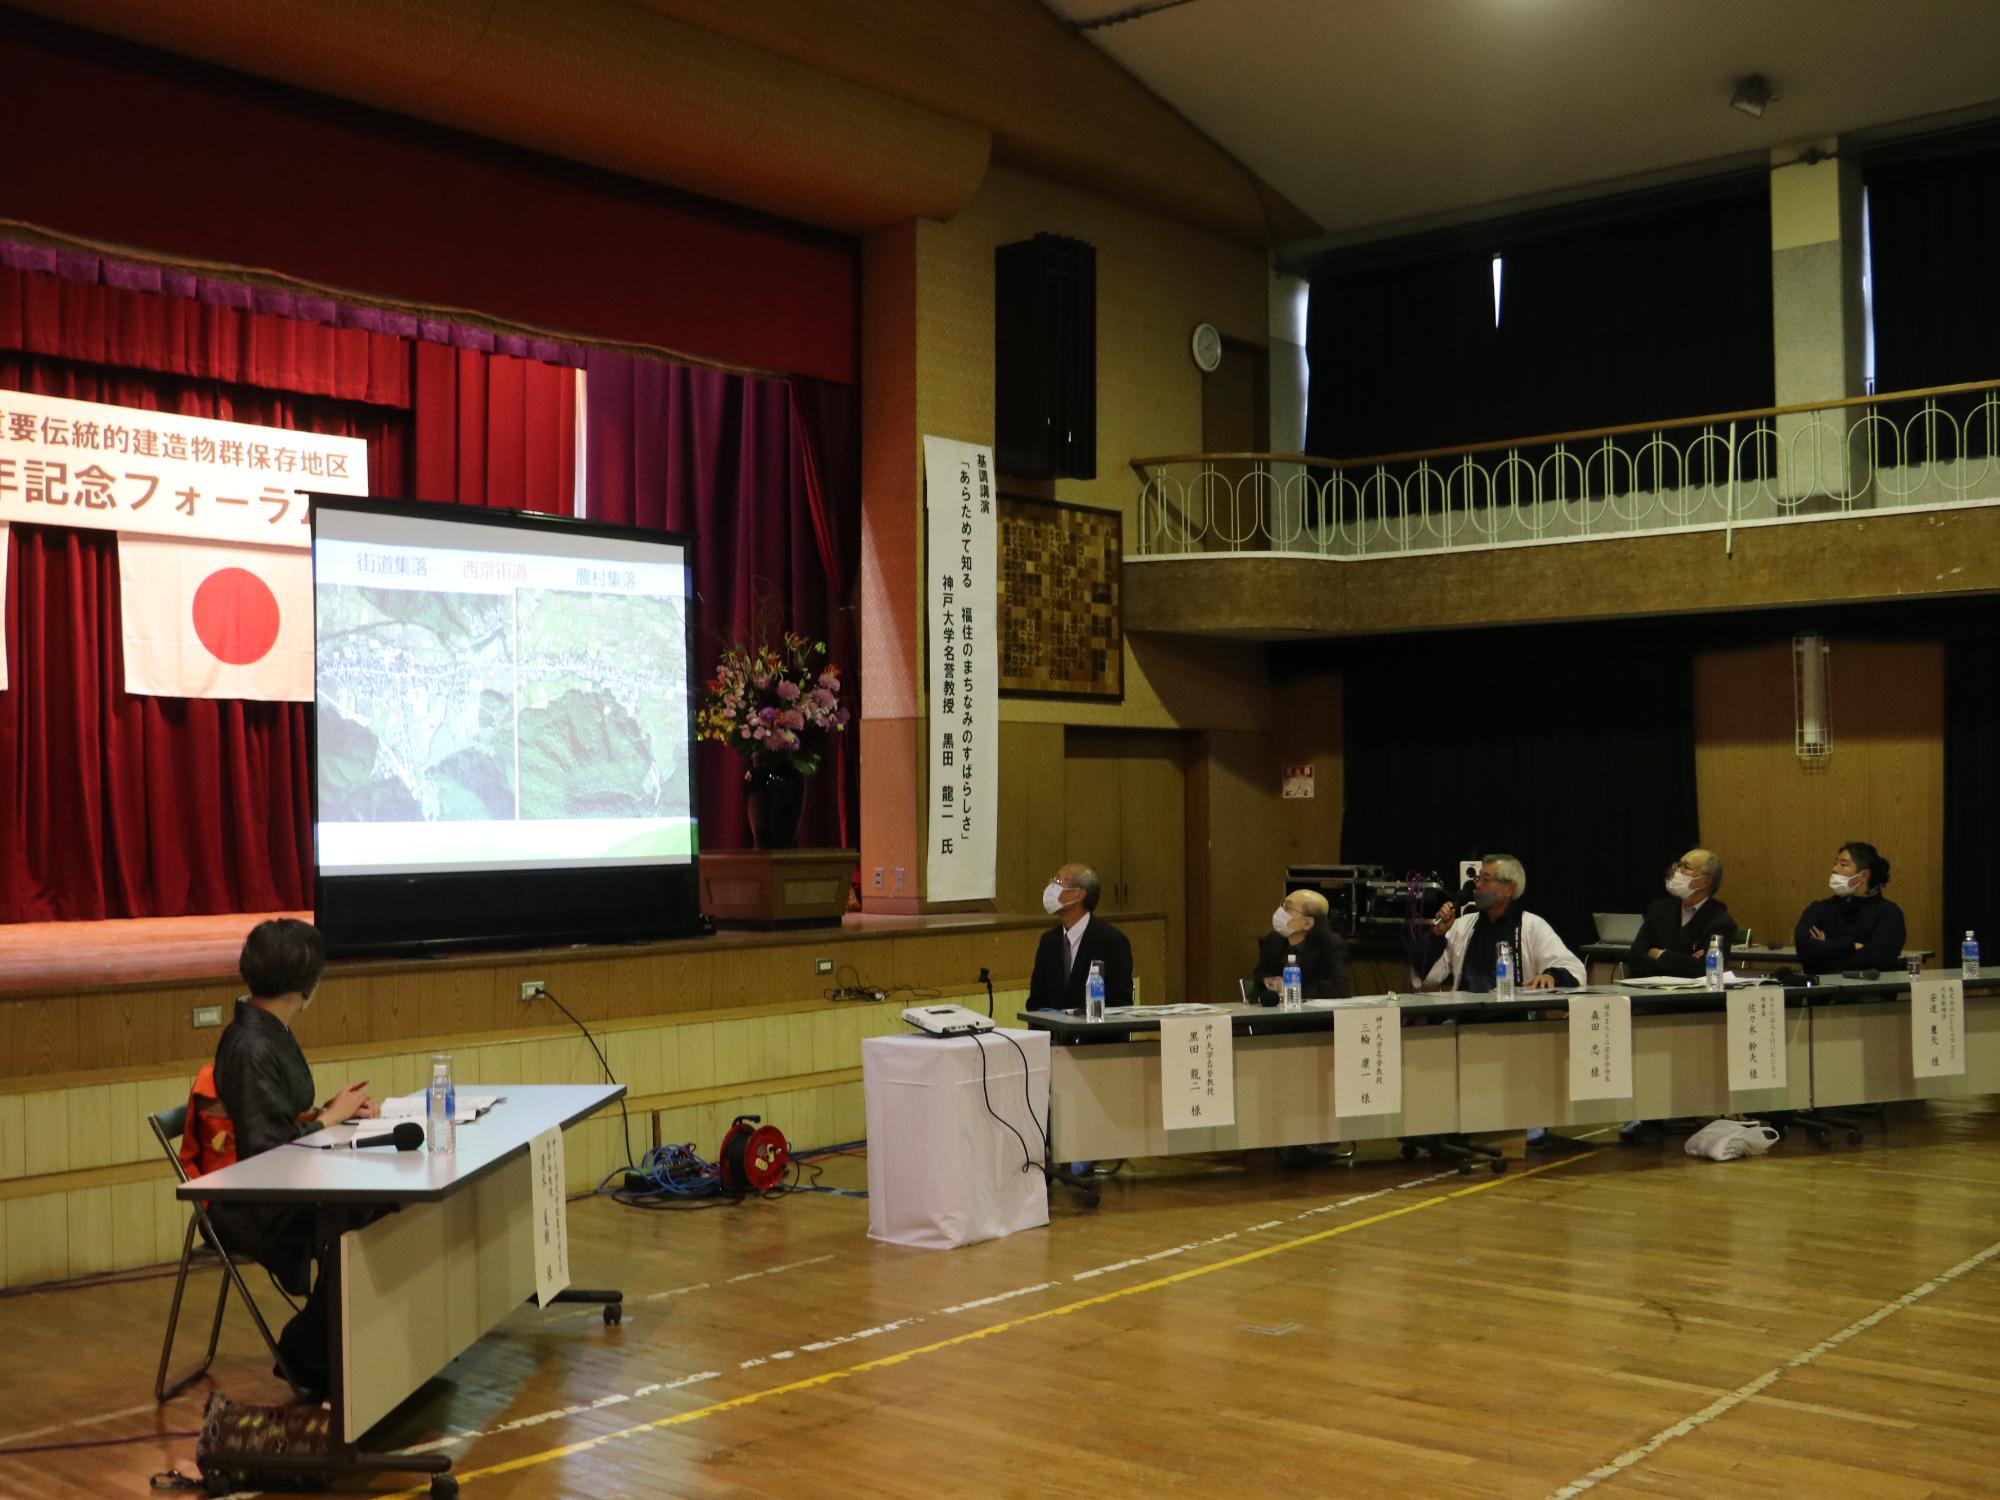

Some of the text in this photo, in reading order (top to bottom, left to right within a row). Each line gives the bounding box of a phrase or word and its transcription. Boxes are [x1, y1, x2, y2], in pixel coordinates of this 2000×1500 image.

[0, 410, 350, 479] 要伝統的建造物群保存地区
[977, 454, 990, 514] 基調講演
[357, 552, 428, 577] 街道集落
[576, 567, 637, 590] 農村集落
[959, 461, 973, 840] 「あらためて知る 福住のまちなみのすばらしさ」
[941, 575, 955, 855] 神戸大学名誉教授 黒田 龍二 氏
[1360, 1023, 1371, 1046] 三輪
[1591, 1009, 1600, 1031] 森田
[1188, 1031, 1202, 1118] 黒田 龍二 様
